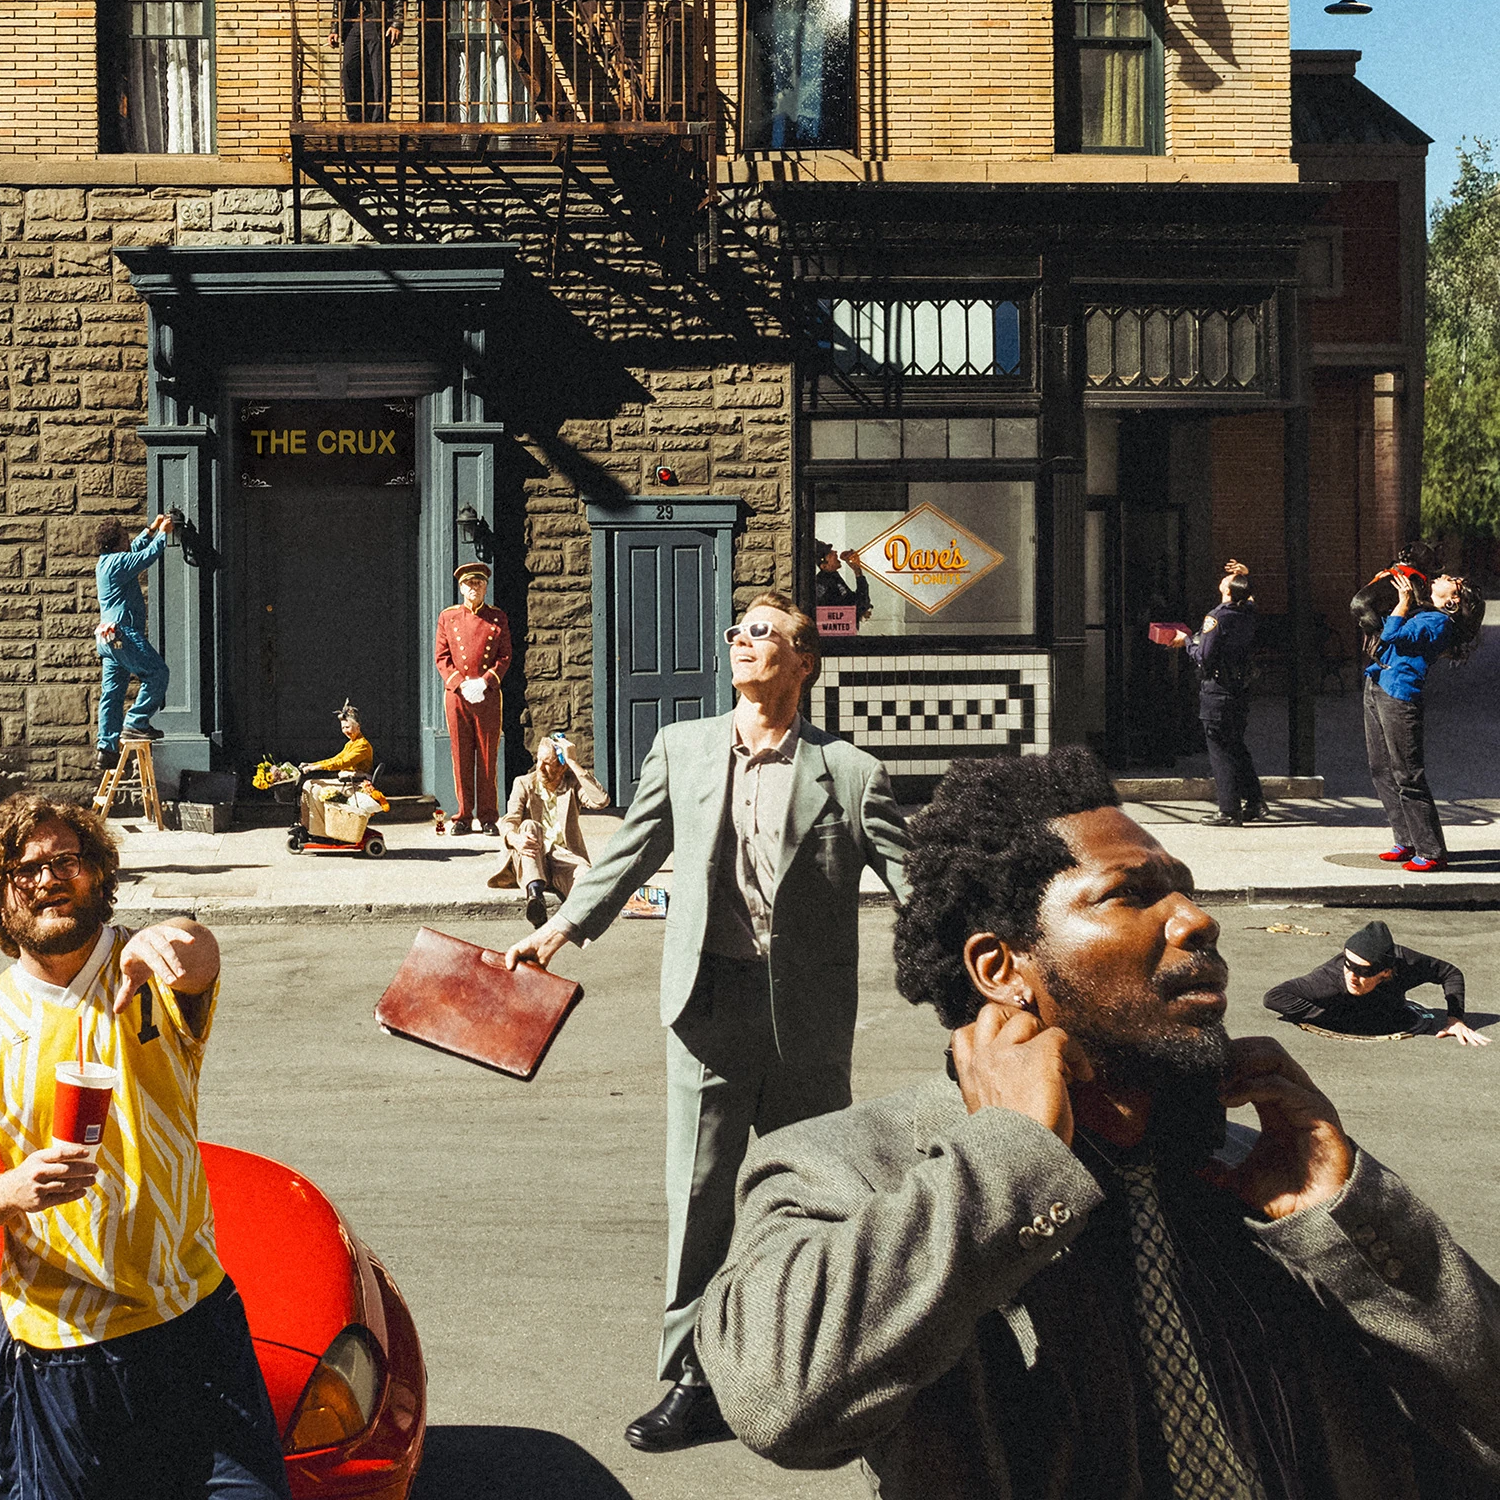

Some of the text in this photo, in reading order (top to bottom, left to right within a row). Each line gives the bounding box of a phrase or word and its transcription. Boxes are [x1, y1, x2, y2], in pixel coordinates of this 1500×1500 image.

[250, 429, 396, 455] THE CRUX
[656, 505, 673, 520] 29
[884, 534, 969, 571] Dave's
[913, 573, 962, 585] DONUTS
[827, 612, 844, 620] HELP
[822, 623, 850, 631] WANTED
